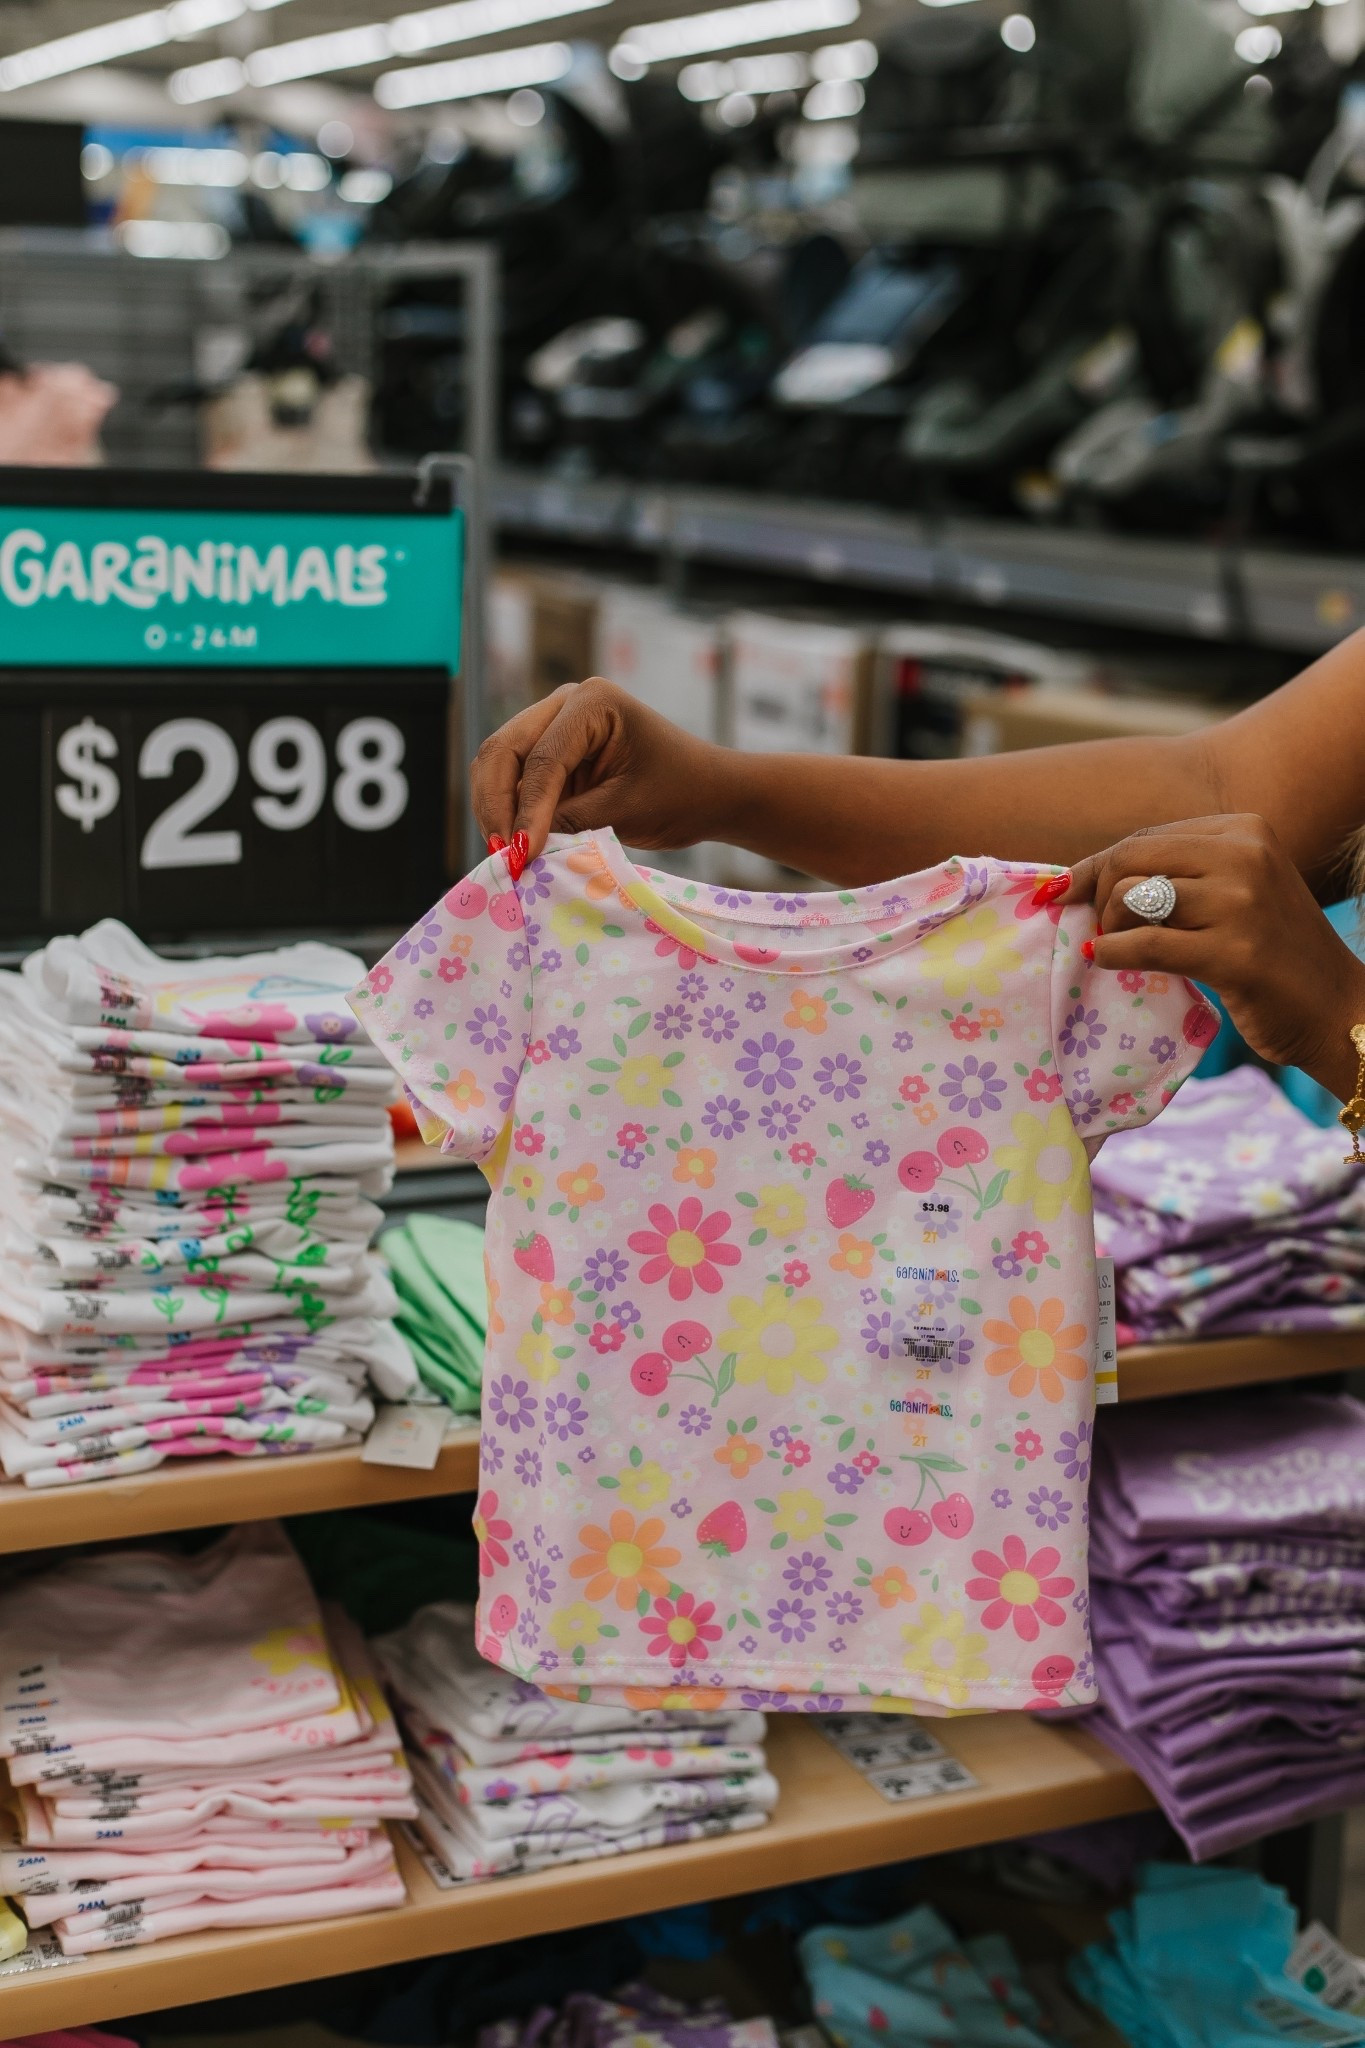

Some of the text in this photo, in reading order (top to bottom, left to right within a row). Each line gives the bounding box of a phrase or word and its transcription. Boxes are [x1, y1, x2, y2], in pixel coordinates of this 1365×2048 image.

[922, 1202, 950, 1213] $3.98
[922, 1231, 938, 1243] 2T
[918, 1303, 934, 1316] 2T
[916, 1369, 931, 1380] 2T
[912, 1435, 928, 1447] 2T
[18, 1856, 46, 1868] 24M
[78, 1899, 105, 1914] 24M
